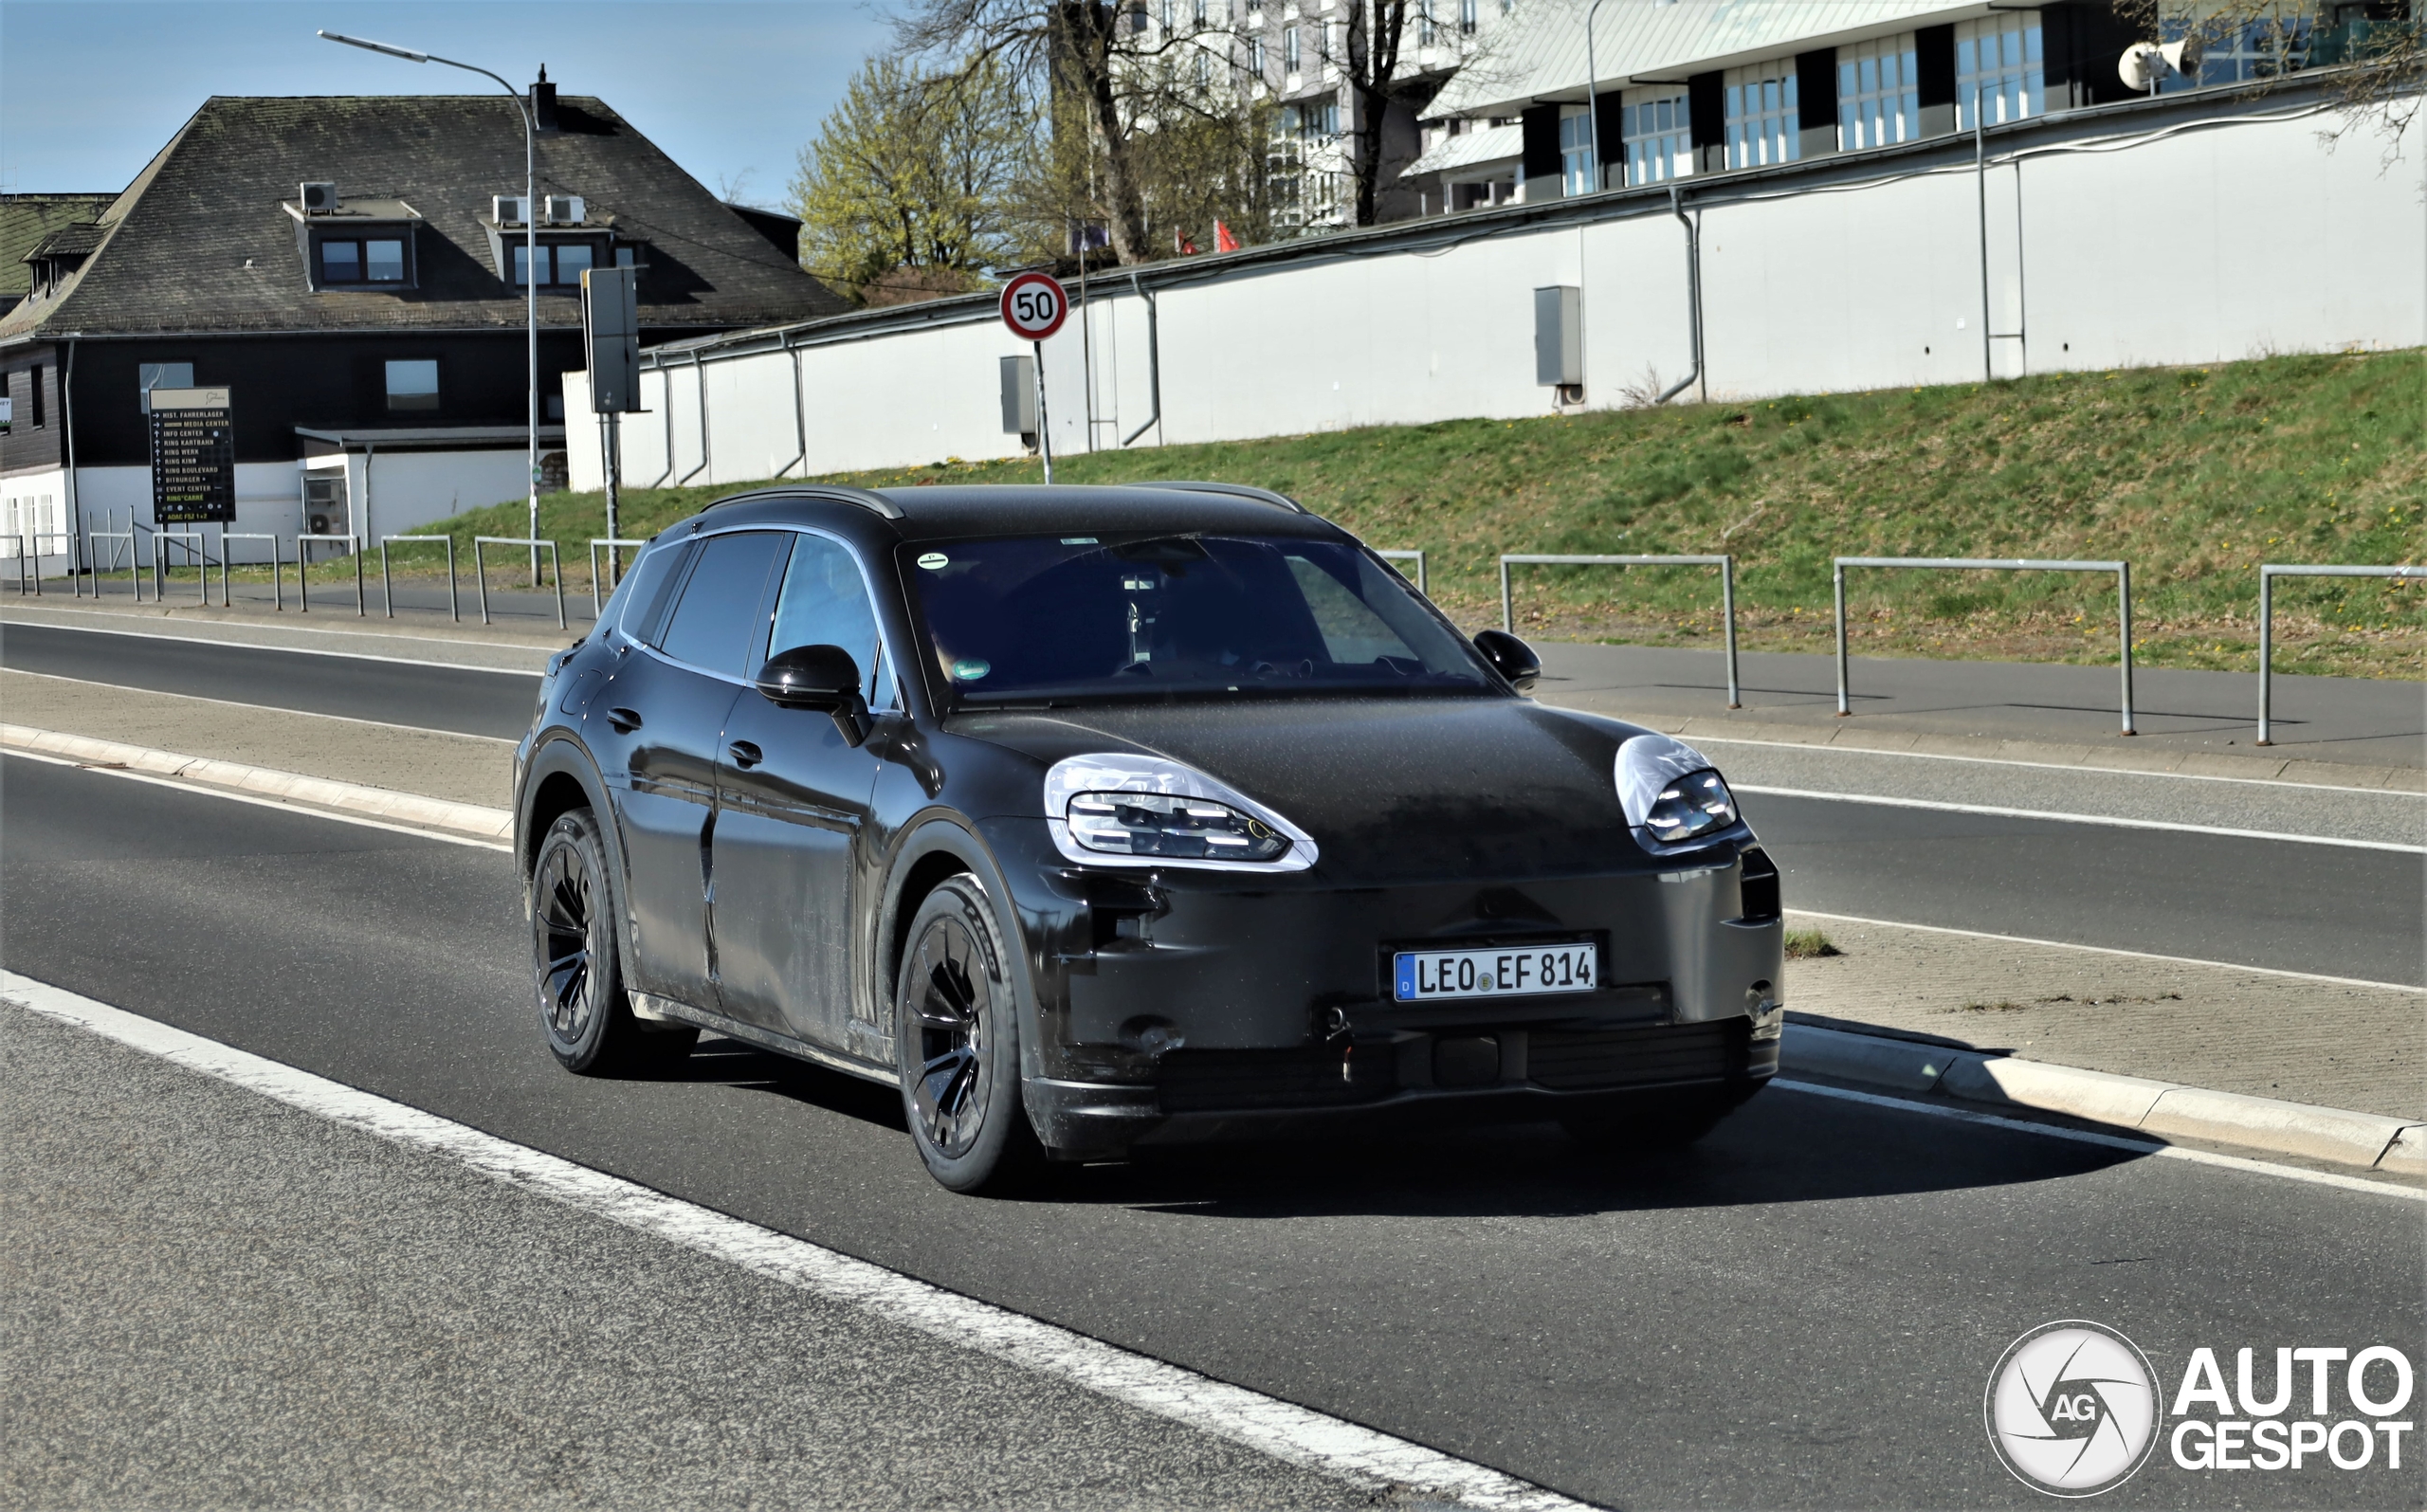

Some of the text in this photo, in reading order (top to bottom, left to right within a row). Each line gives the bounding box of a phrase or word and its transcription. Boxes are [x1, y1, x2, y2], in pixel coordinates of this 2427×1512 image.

[1016, 291, 1053, 322] 50
[1401, 951, 1591, 993] D LEO EF 814
